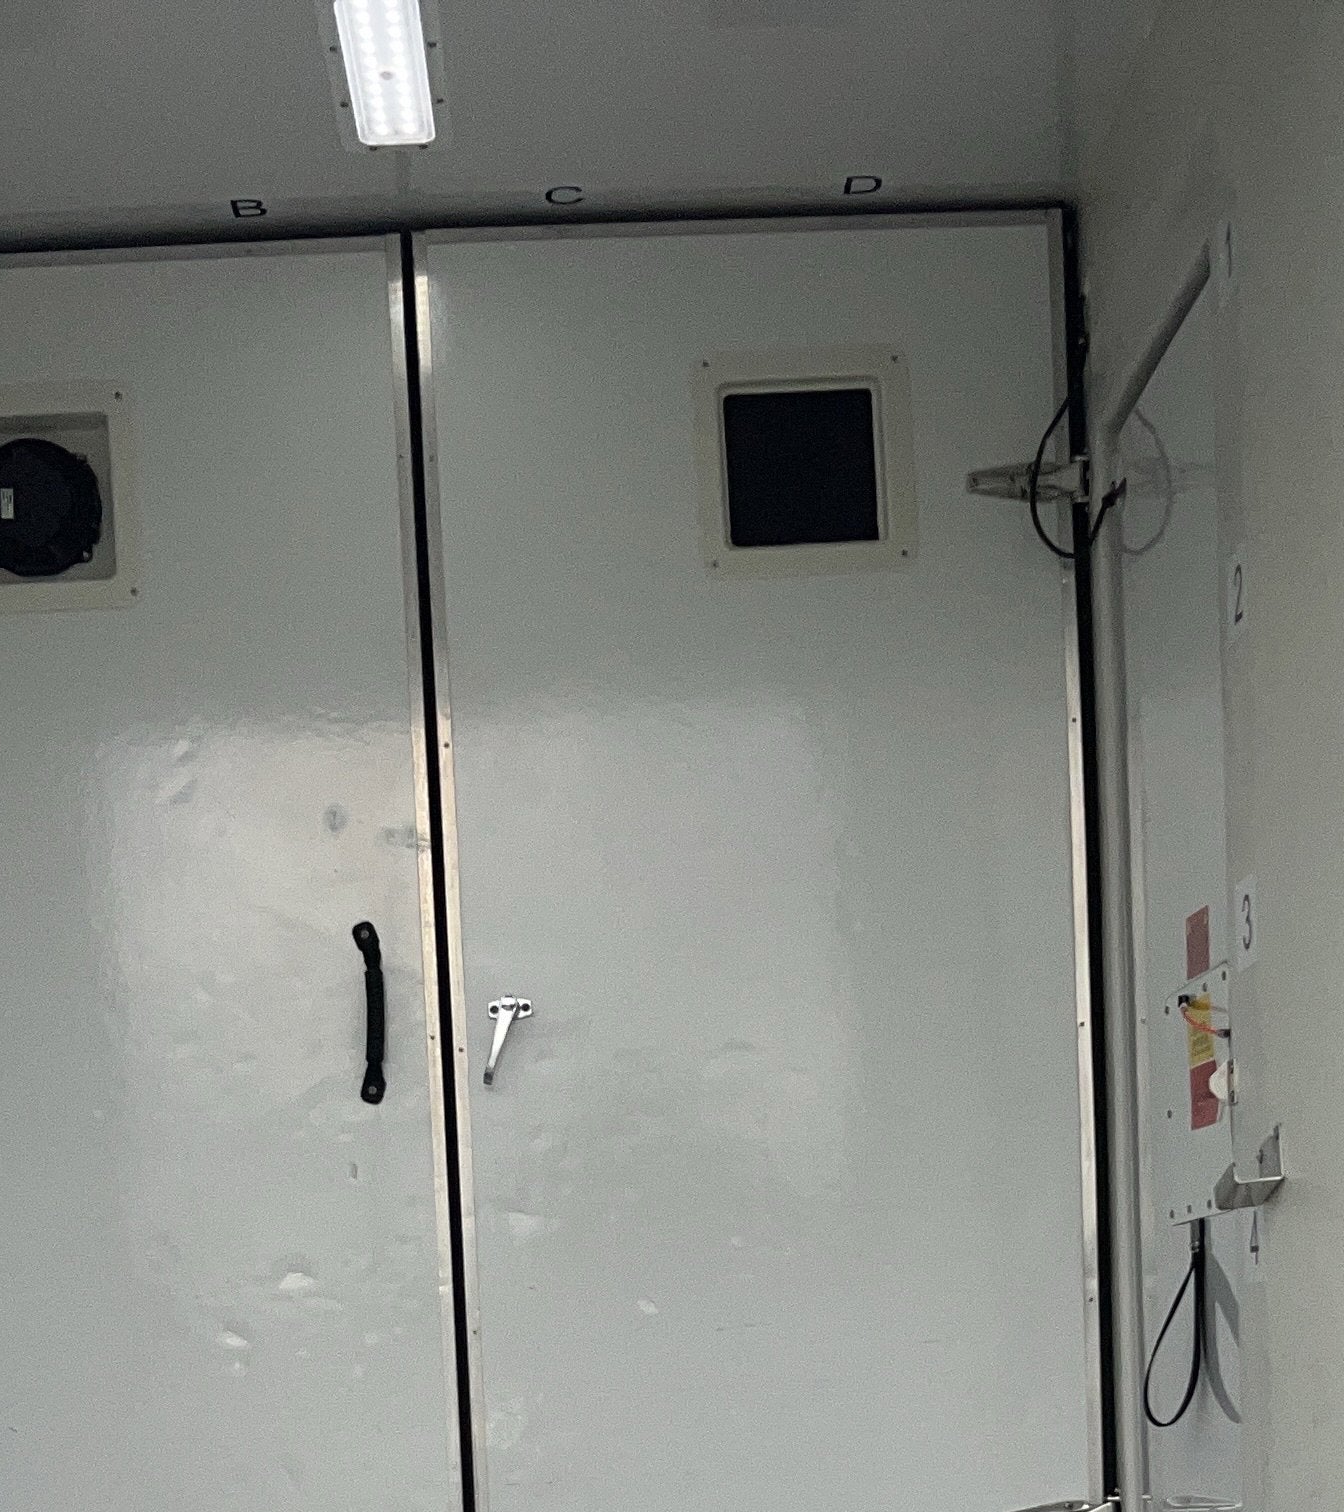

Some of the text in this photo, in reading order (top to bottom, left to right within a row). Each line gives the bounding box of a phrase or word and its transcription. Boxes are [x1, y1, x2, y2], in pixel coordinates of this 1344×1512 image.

[229, 198, 268, 219] B
[544, 185, 585, 206] C
[843, 174, 883, 195] D
[1240, 893, 1254, 952] 3
